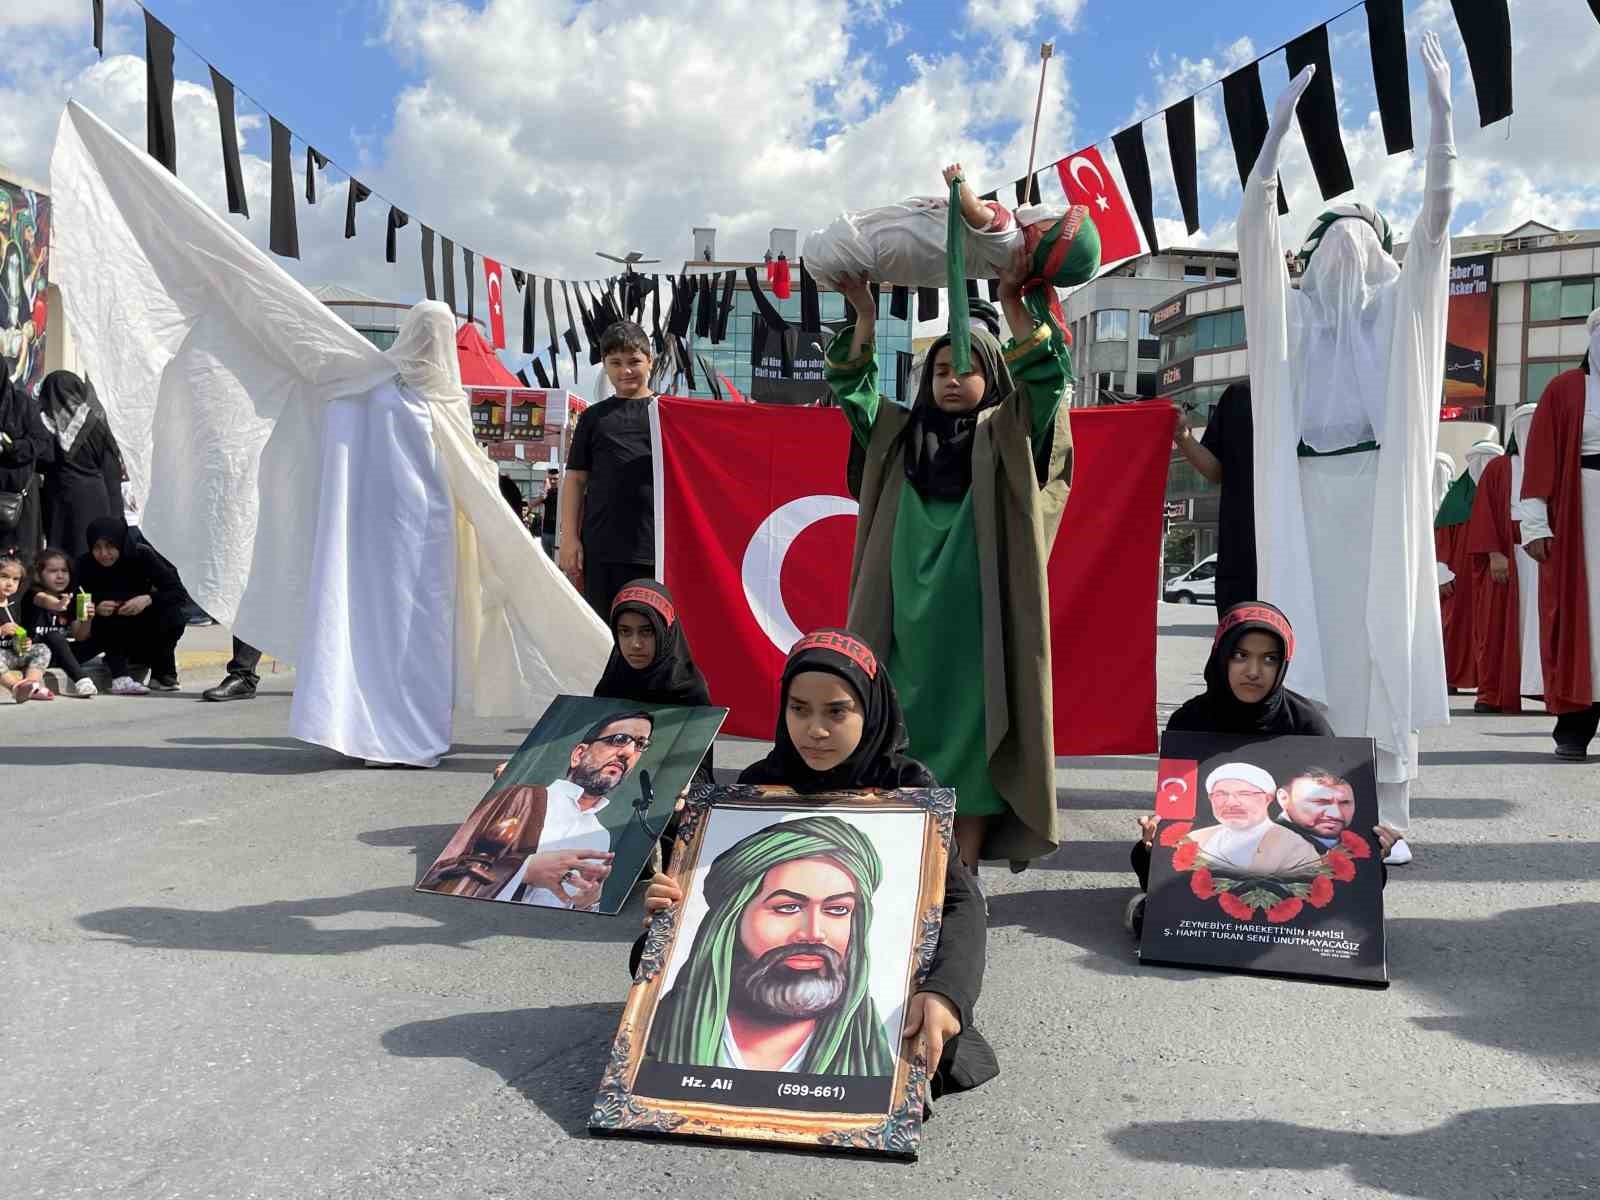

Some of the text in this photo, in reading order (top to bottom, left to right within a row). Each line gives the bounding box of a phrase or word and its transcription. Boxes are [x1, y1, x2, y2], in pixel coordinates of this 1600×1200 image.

[1163, 928, 1174, 937] Ş.
[1211, 931, 1244, 941] TURAN
[681, 1076, 846, 1100] Hz. Ali (599-661)
